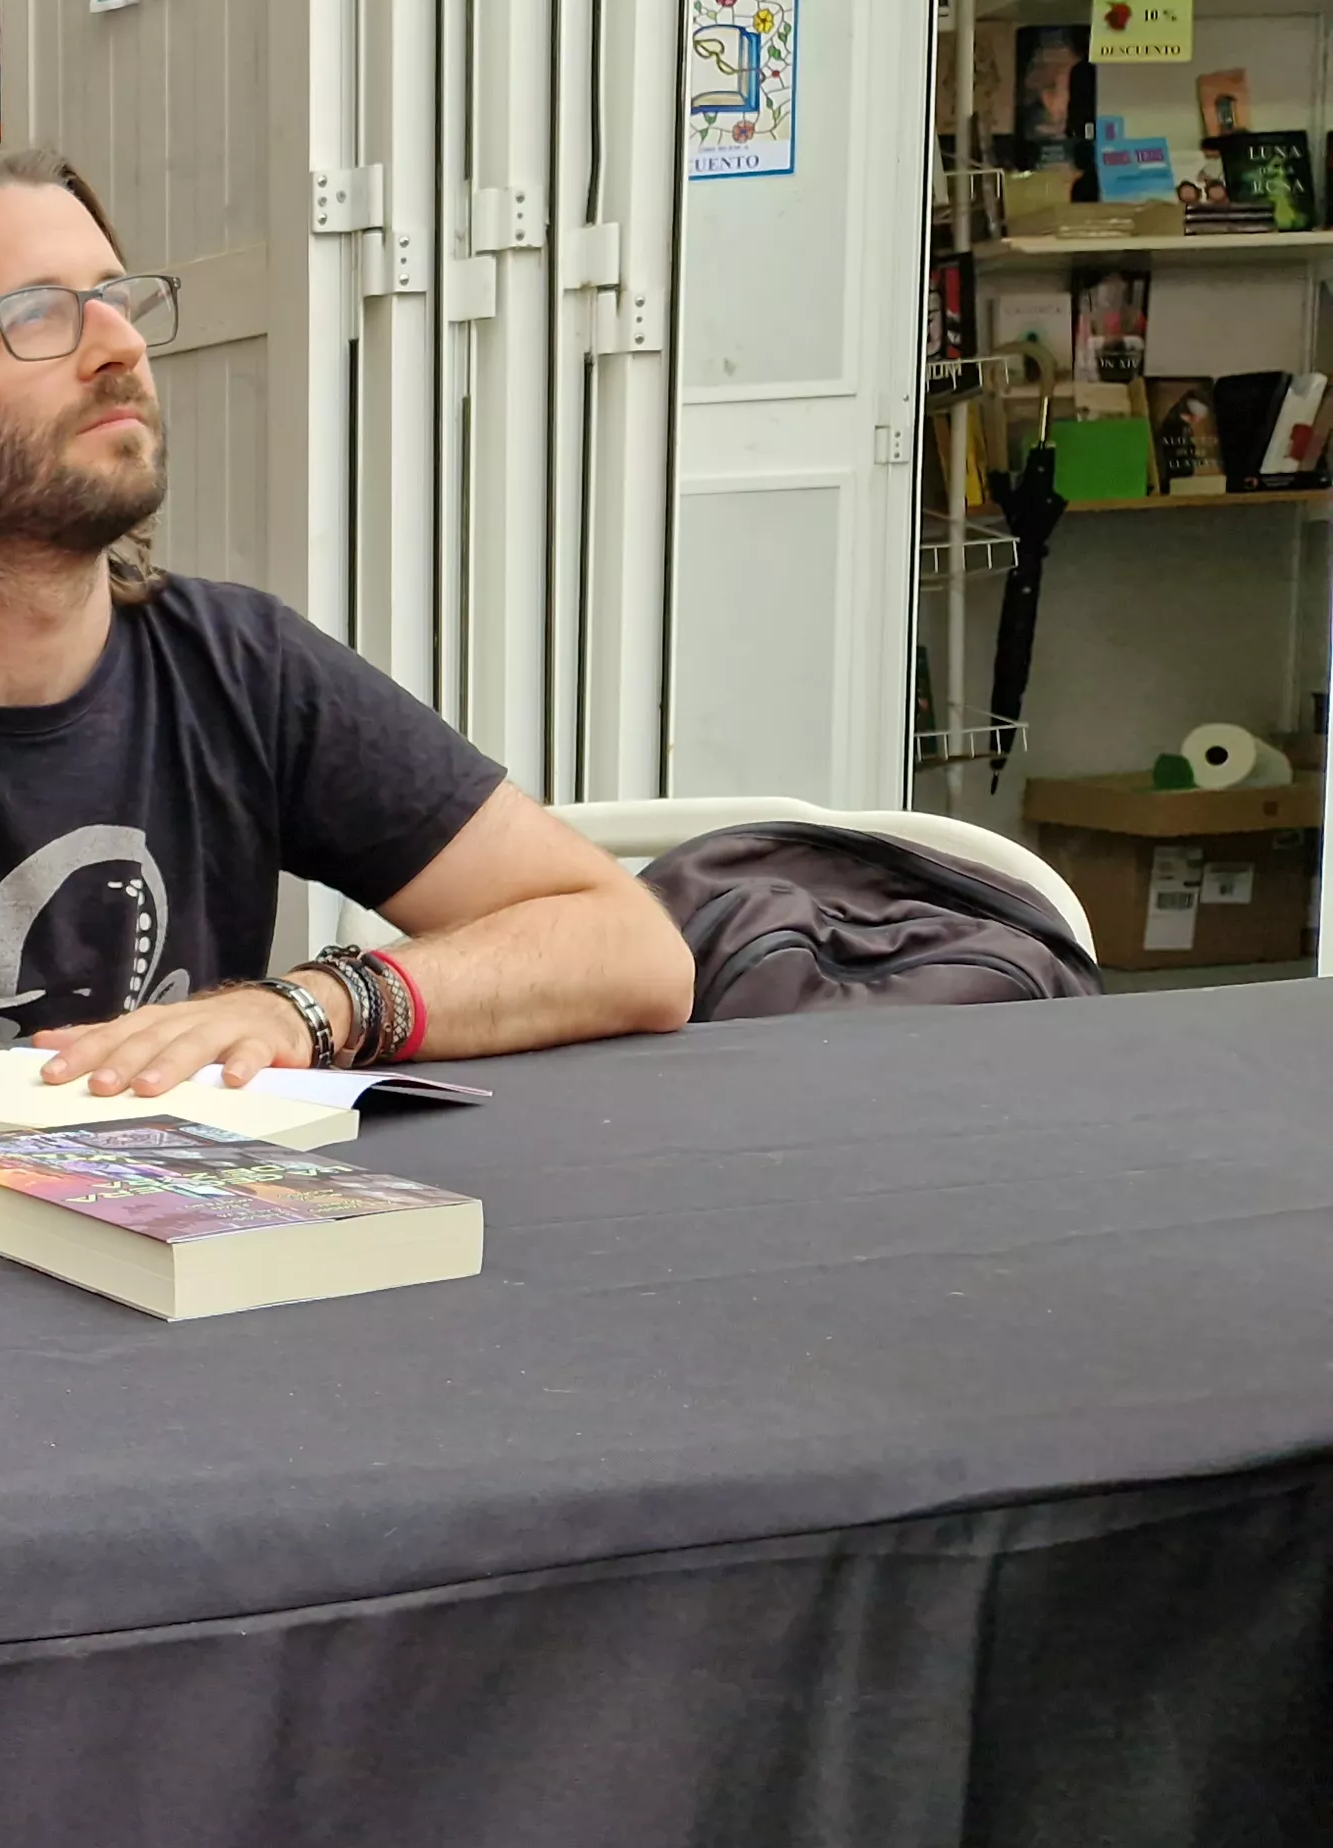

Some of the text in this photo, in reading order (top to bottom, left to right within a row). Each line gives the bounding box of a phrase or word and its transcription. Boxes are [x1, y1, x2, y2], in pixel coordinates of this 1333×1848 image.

[1144, 9, 1158, 21] 10
[1100, 45, 1181, 56] DESCUENTO
[1248, 145, 1301, 160] LUNA
